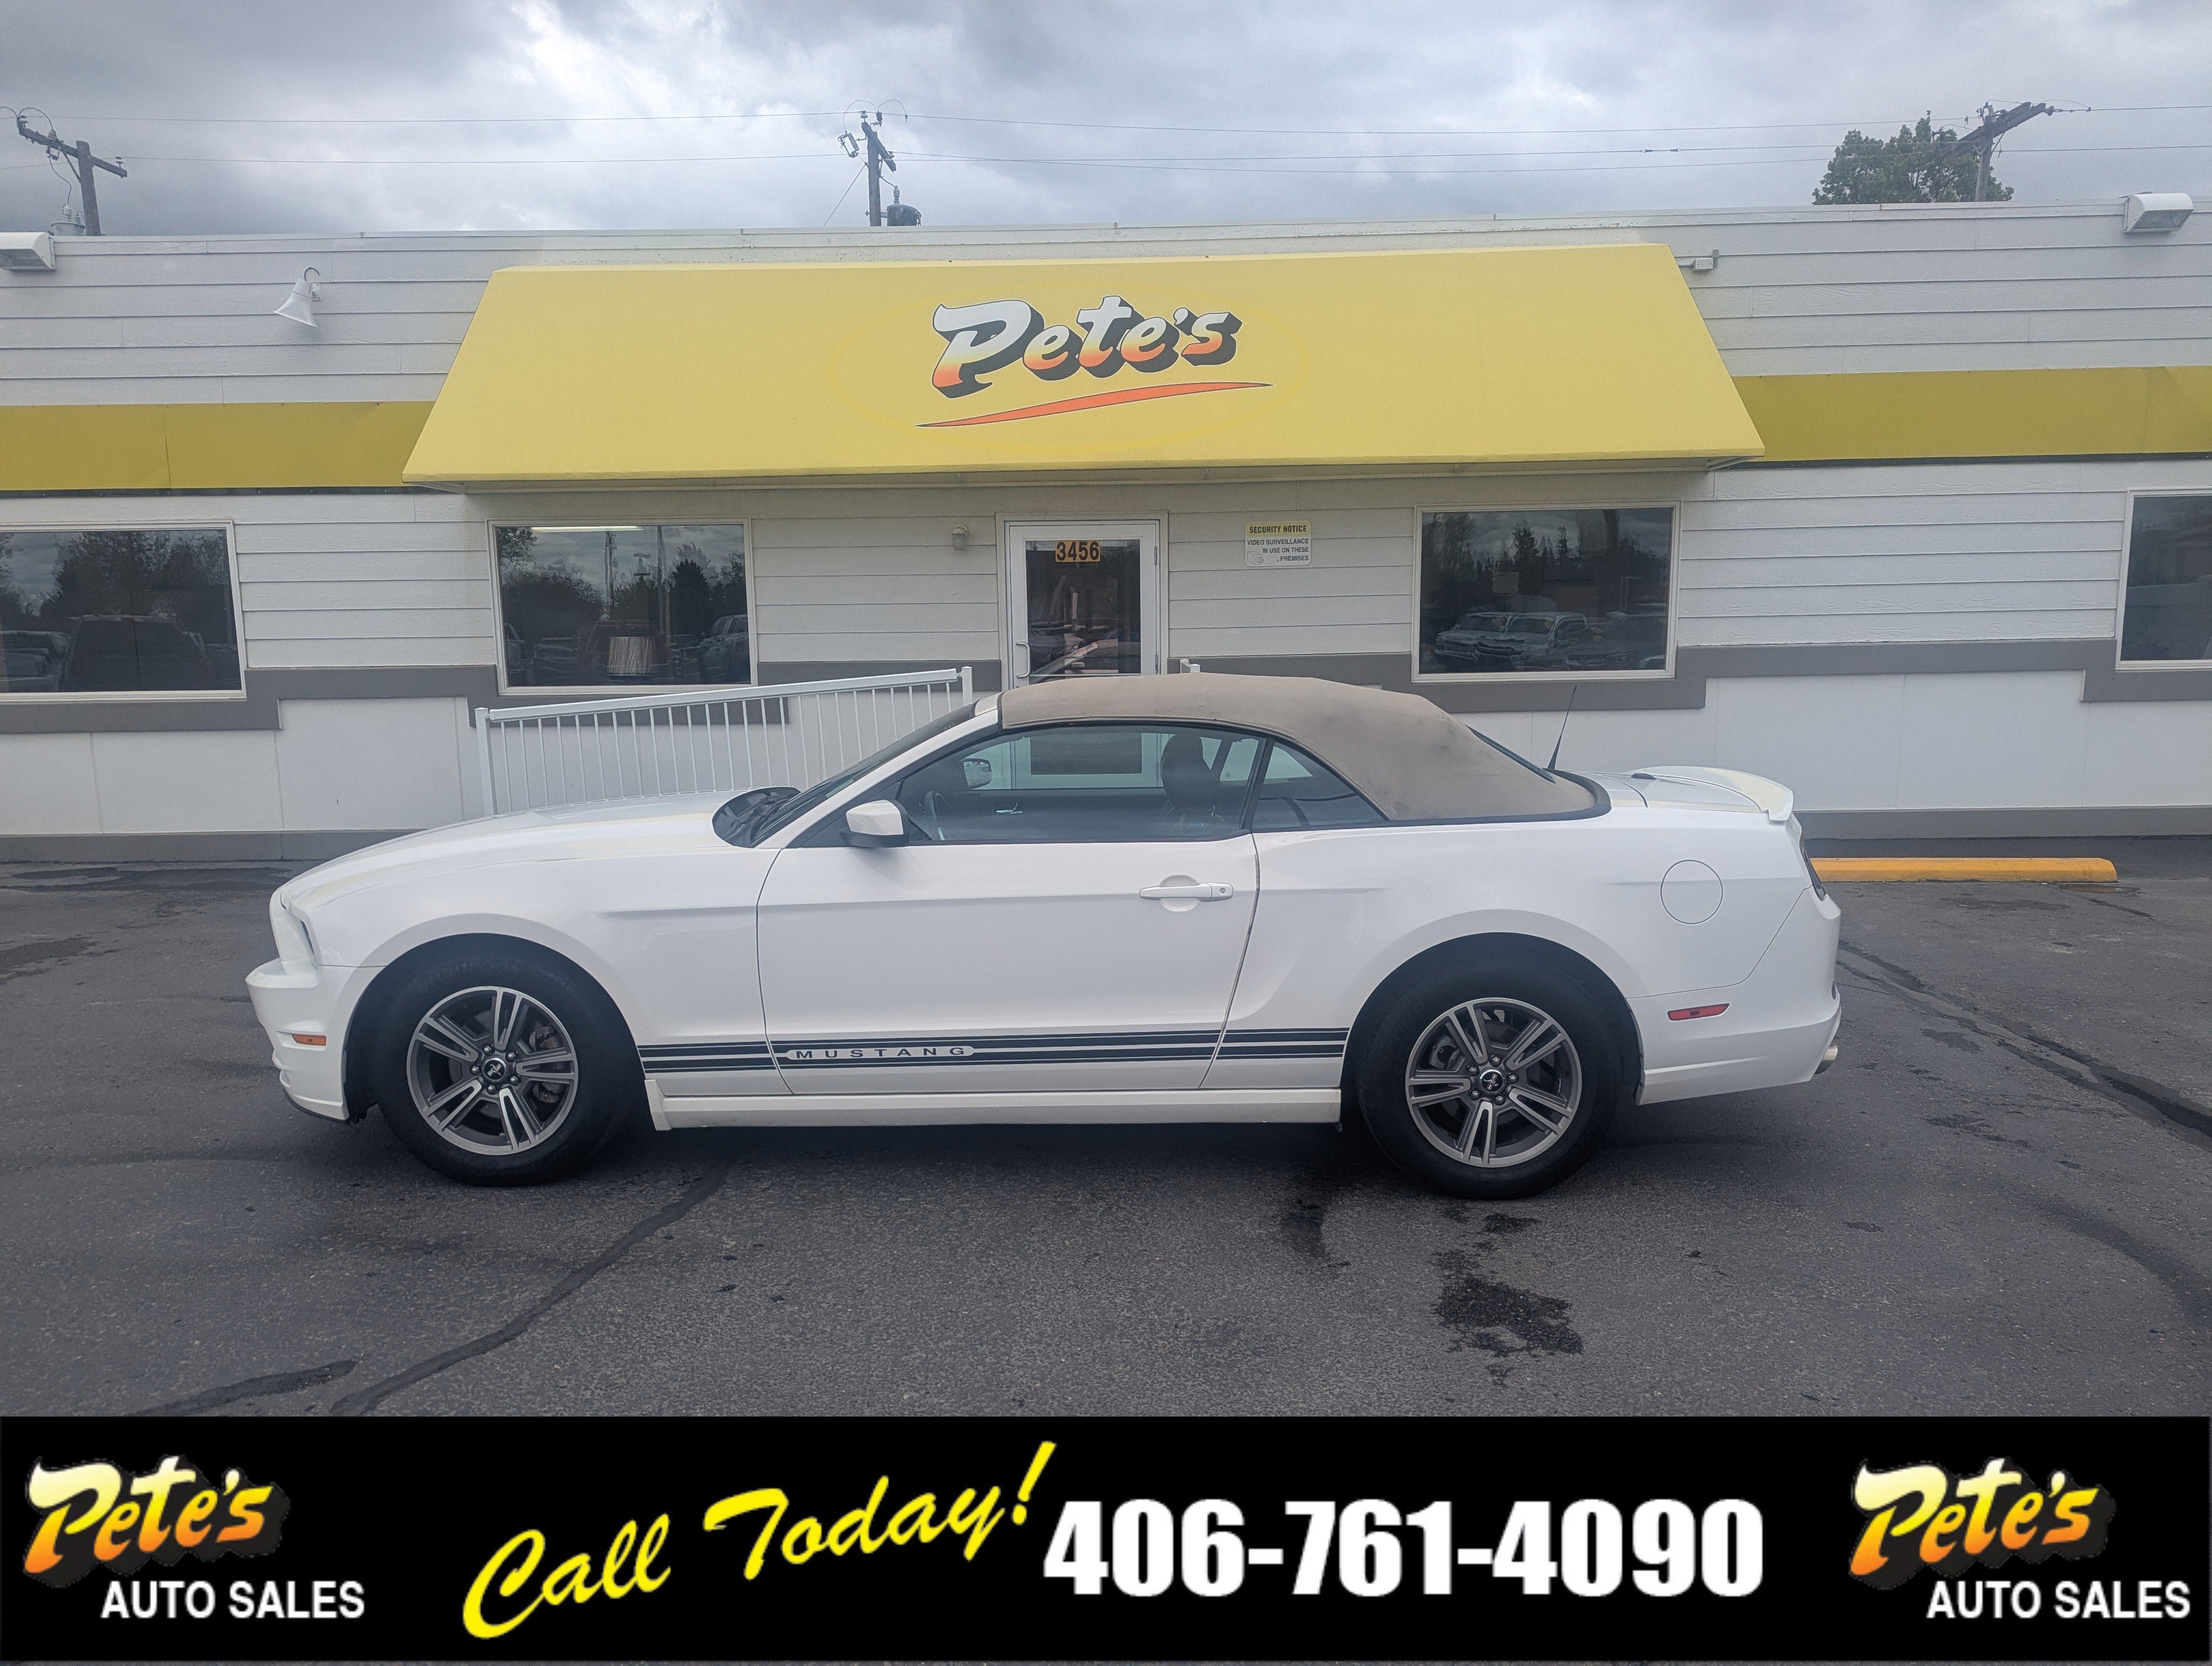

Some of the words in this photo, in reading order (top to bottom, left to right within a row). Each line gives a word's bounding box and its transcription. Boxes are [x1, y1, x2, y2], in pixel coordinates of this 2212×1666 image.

[931, 296, 1242, 399] Pete's
[1249, 526, 1281, 534] SECURITY
[1056, 541, 1099, 561] 3456
[796, 1047, 964, 1059] MUSTANG
